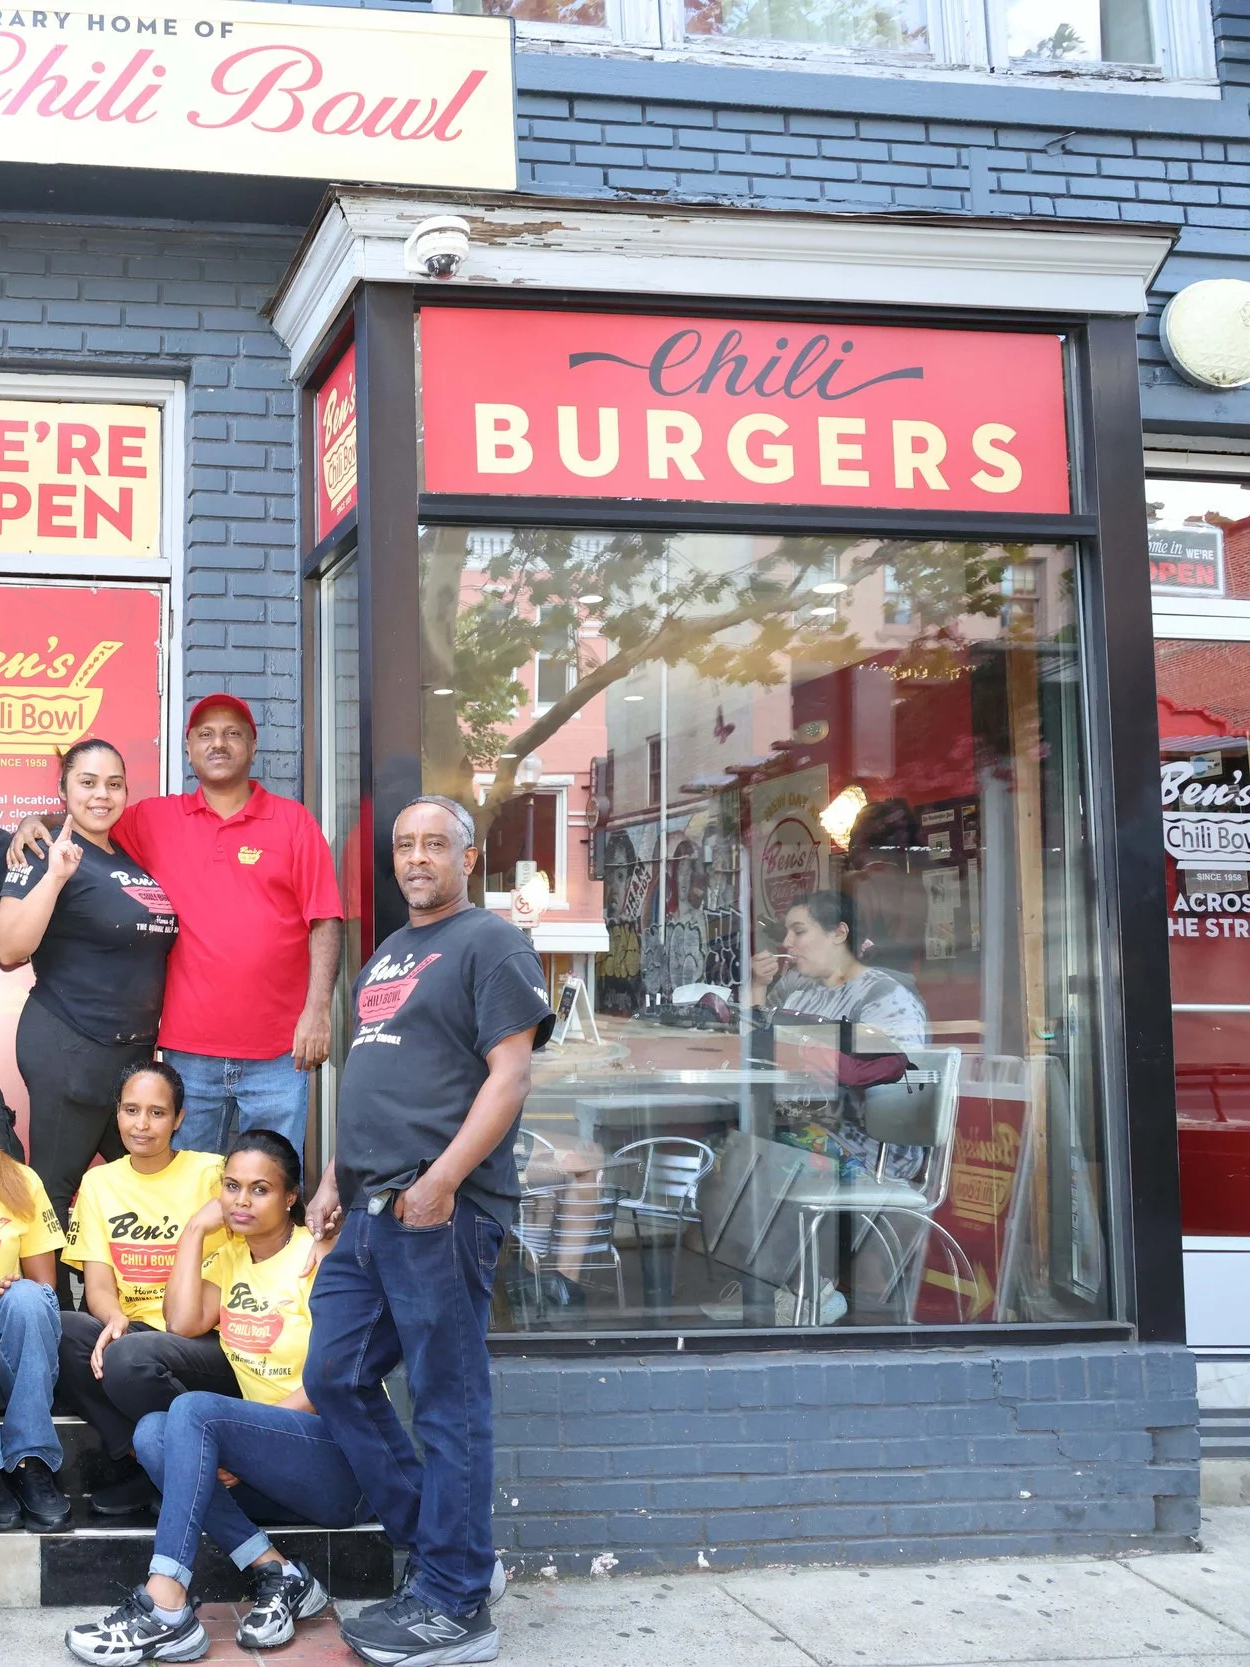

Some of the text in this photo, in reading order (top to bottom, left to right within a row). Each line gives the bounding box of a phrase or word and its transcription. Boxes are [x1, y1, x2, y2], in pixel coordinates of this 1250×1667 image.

[87, 14, 178, 37] HOME
[194, 20, 234, 39] OF
[186, 45, 489, 142] Bowl
[569, 329, 924, 400] Chili
[474, 402, 1023, 494] BURGERS
[1186, 548, 1214, 560] WE'RE
[21, 703, 84, 730] Bowl
[25, 758, 48, 768] 1958
[1160, 760, 1250, 807] Ben's
[13, 794, 61, 805] location
[1166, 824, 1212, 849] Chili
[1196, 872, 1242, 881] SINCE 1958
[365, 953, 416, 986] Ben's
[108, 1211, 179, 1241] Ben's
[121, 1253, 147, 1266] CHILI
[133, 1286, 157, 1295] Home
[268, 1367, 291, 1376] SMOKE
